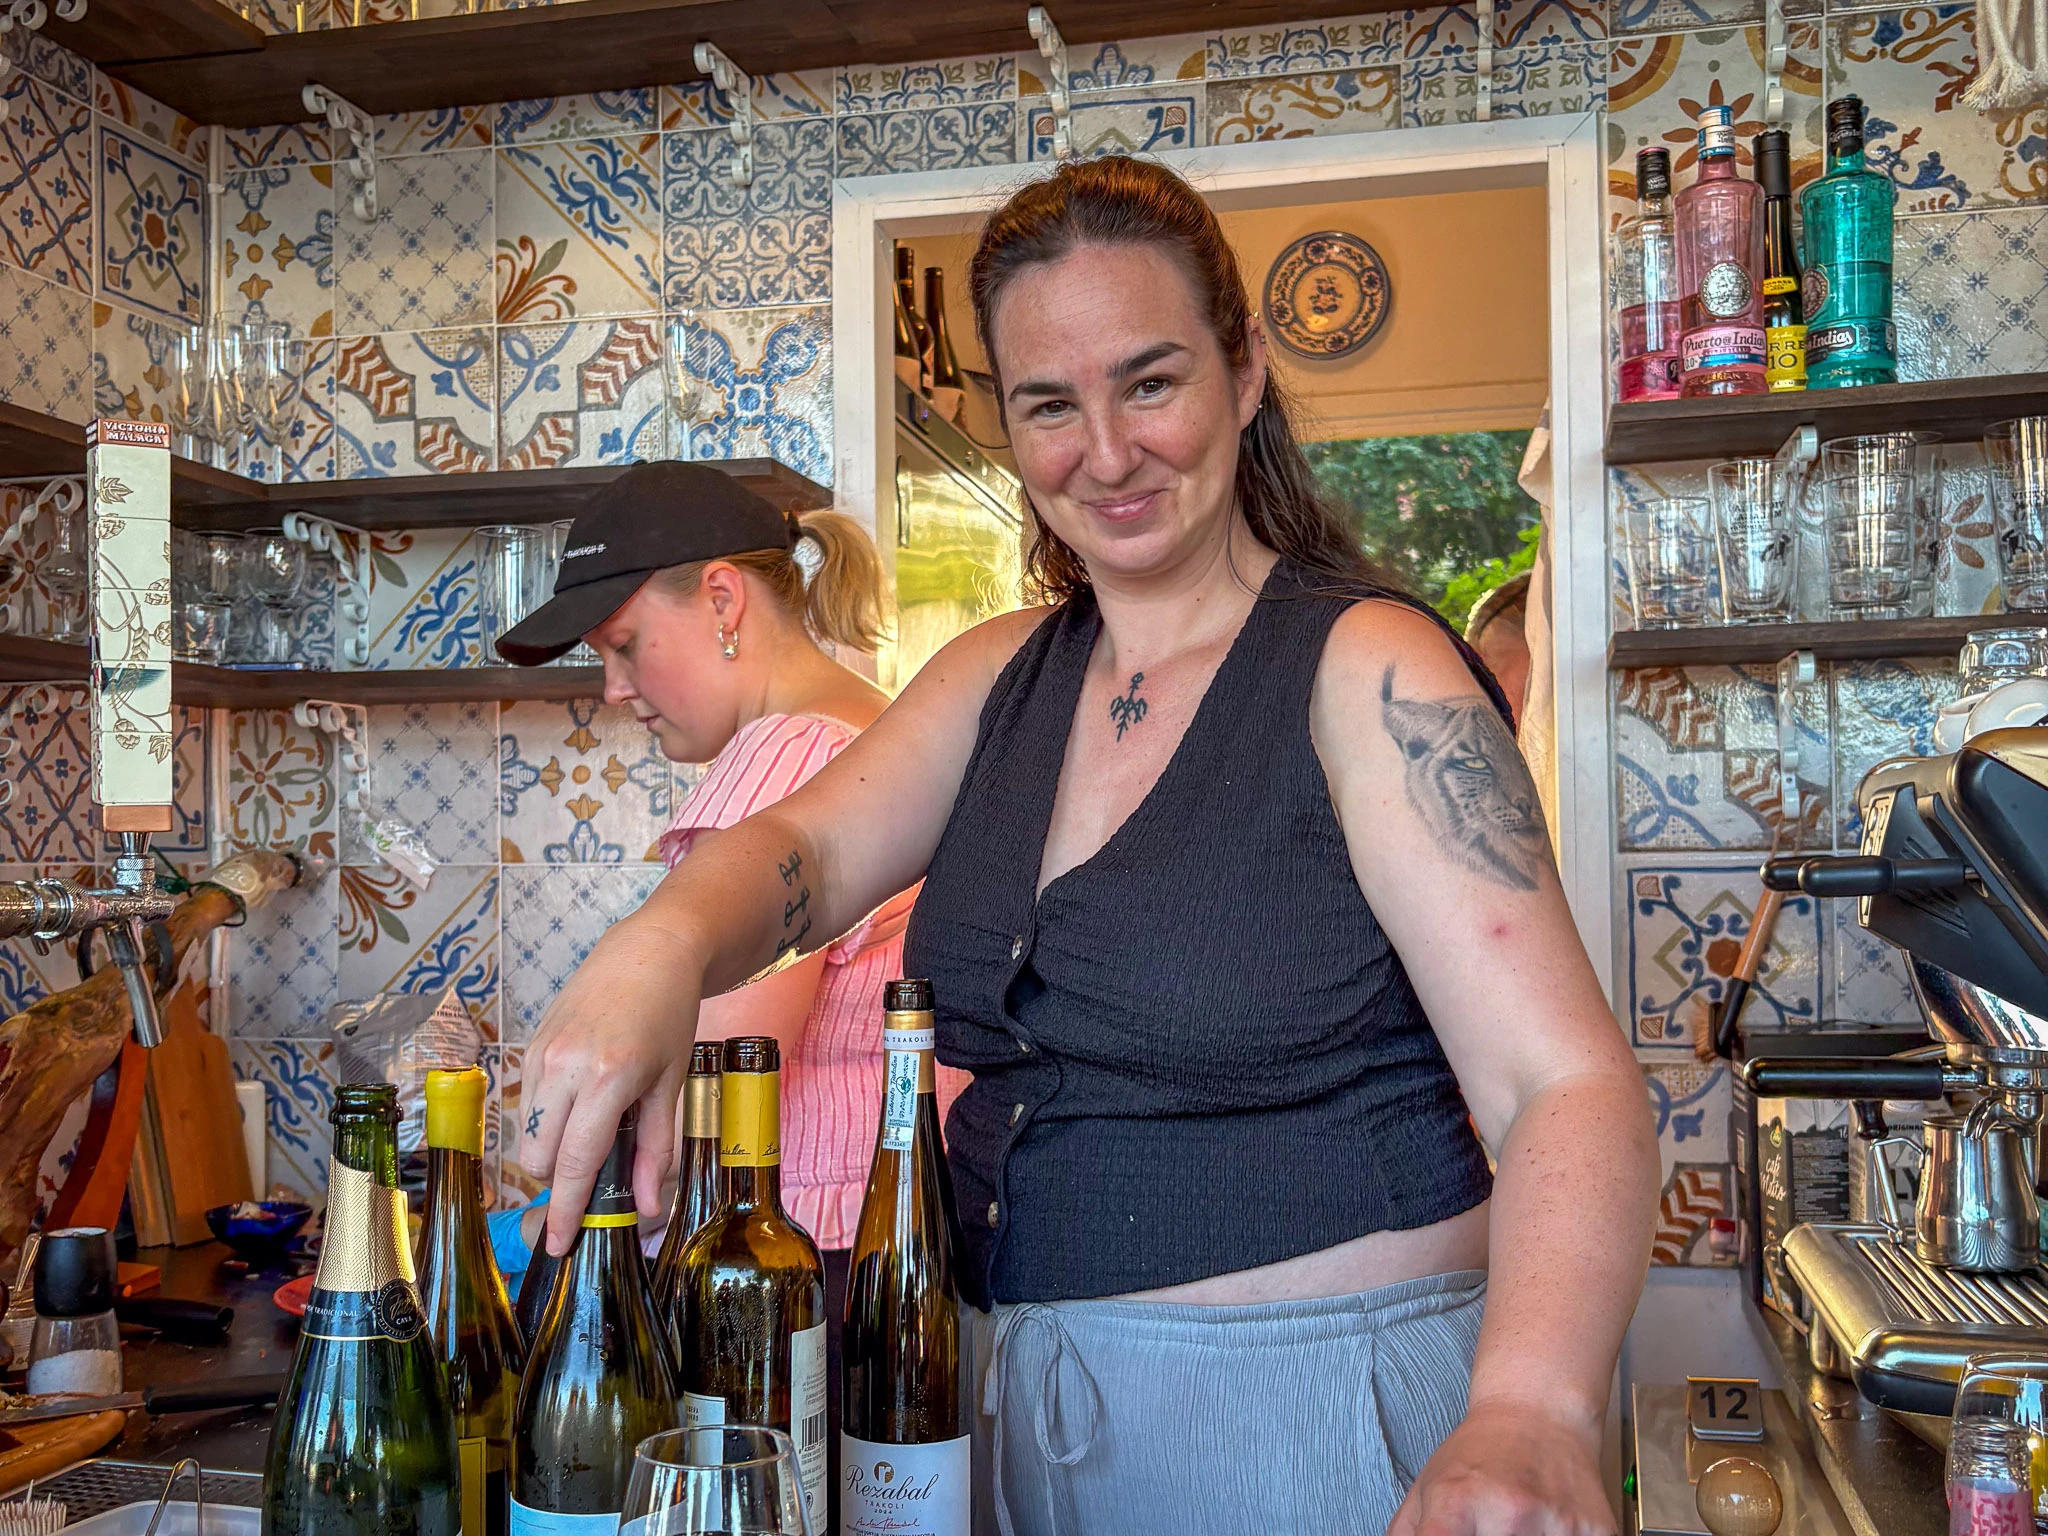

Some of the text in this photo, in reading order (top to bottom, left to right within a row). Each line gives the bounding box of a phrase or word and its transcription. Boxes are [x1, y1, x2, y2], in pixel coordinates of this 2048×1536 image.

[1684, 336, 1722, 355] Puerto
[1811, 330, 1853, 349] Indias
[1767, 352, 1798, 370] 10
[104, 421, 167, 435] VICTORIA
[314, 1307, 359, 1317] TRADICIONAL
[396, 1316, 412, 1326] CAVA
[1699, 1385, 1749, 1420] 12
[845, 1464, 940, 1501] Rezabal
[865, 1499, 904, 1510] TXAKOLI
